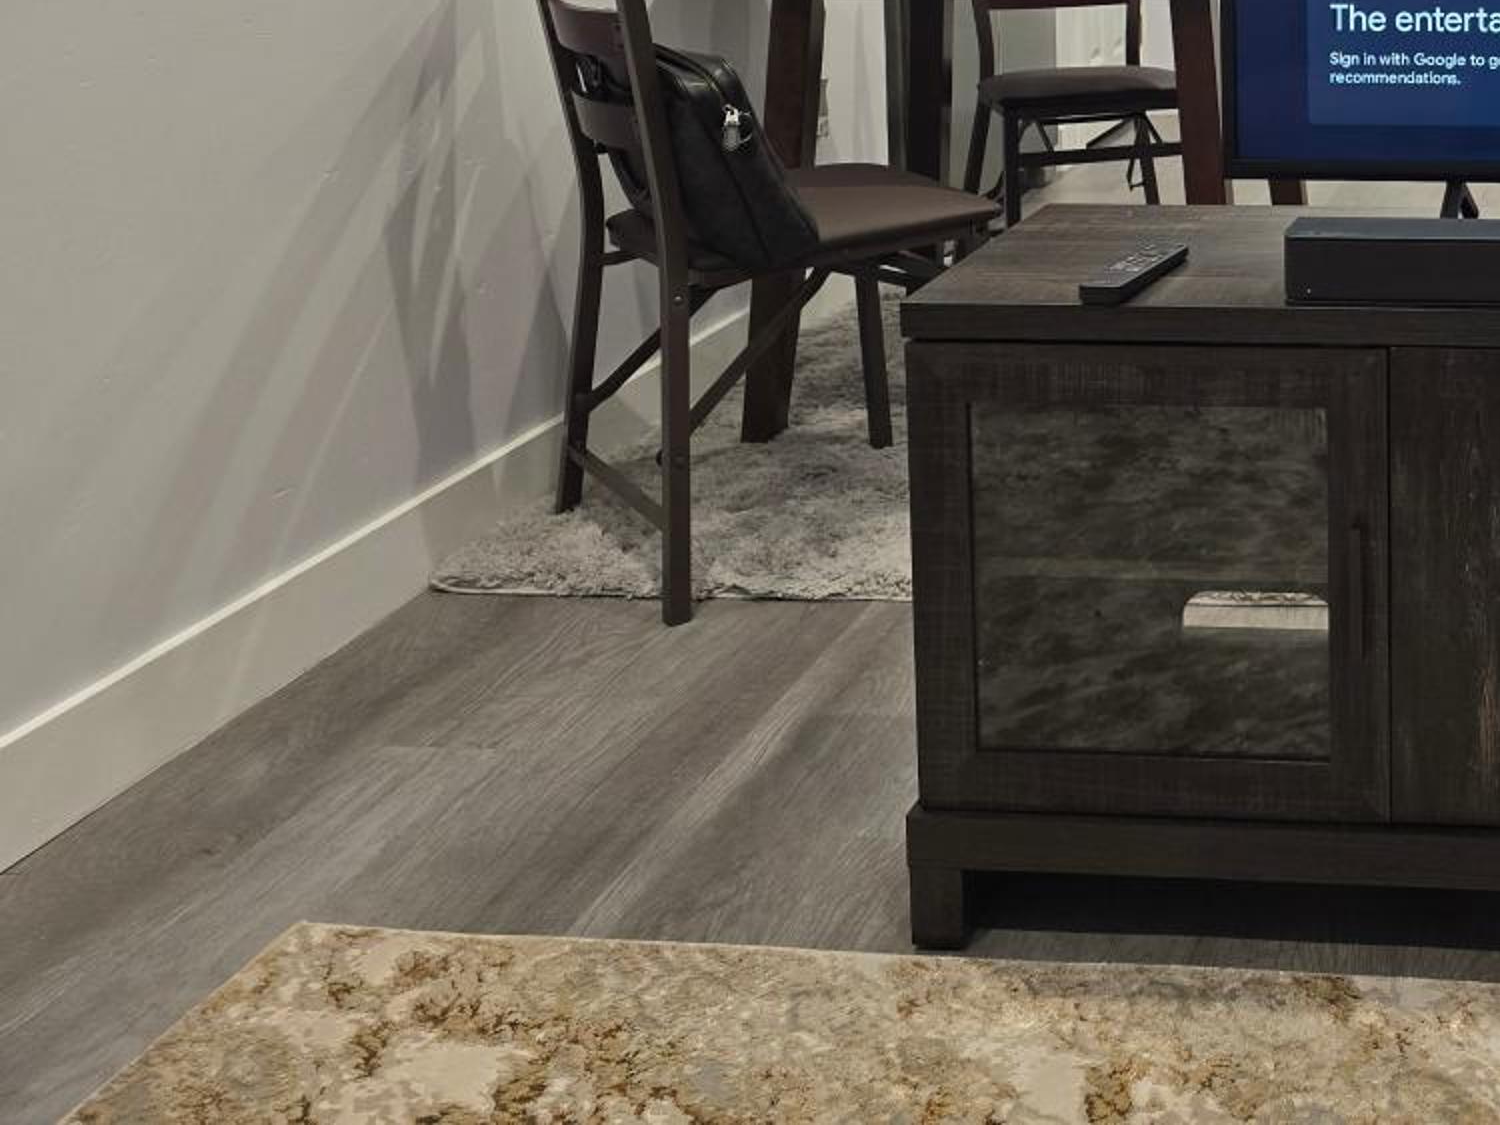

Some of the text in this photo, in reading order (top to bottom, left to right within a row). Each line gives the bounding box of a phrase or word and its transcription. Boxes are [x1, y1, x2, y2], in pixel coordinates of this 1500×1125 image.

[1329, 4, 1387, 32] The
[1329, 52, 1360, 68] Sign
[1363, 53, 1376, 66] in
[1379, 53, 1410, 66] with
[1413, 52, 1466, 69] Google
[1470, 55, 1485, 67] to
[1329, 72, 1461, 85] recommendations.
